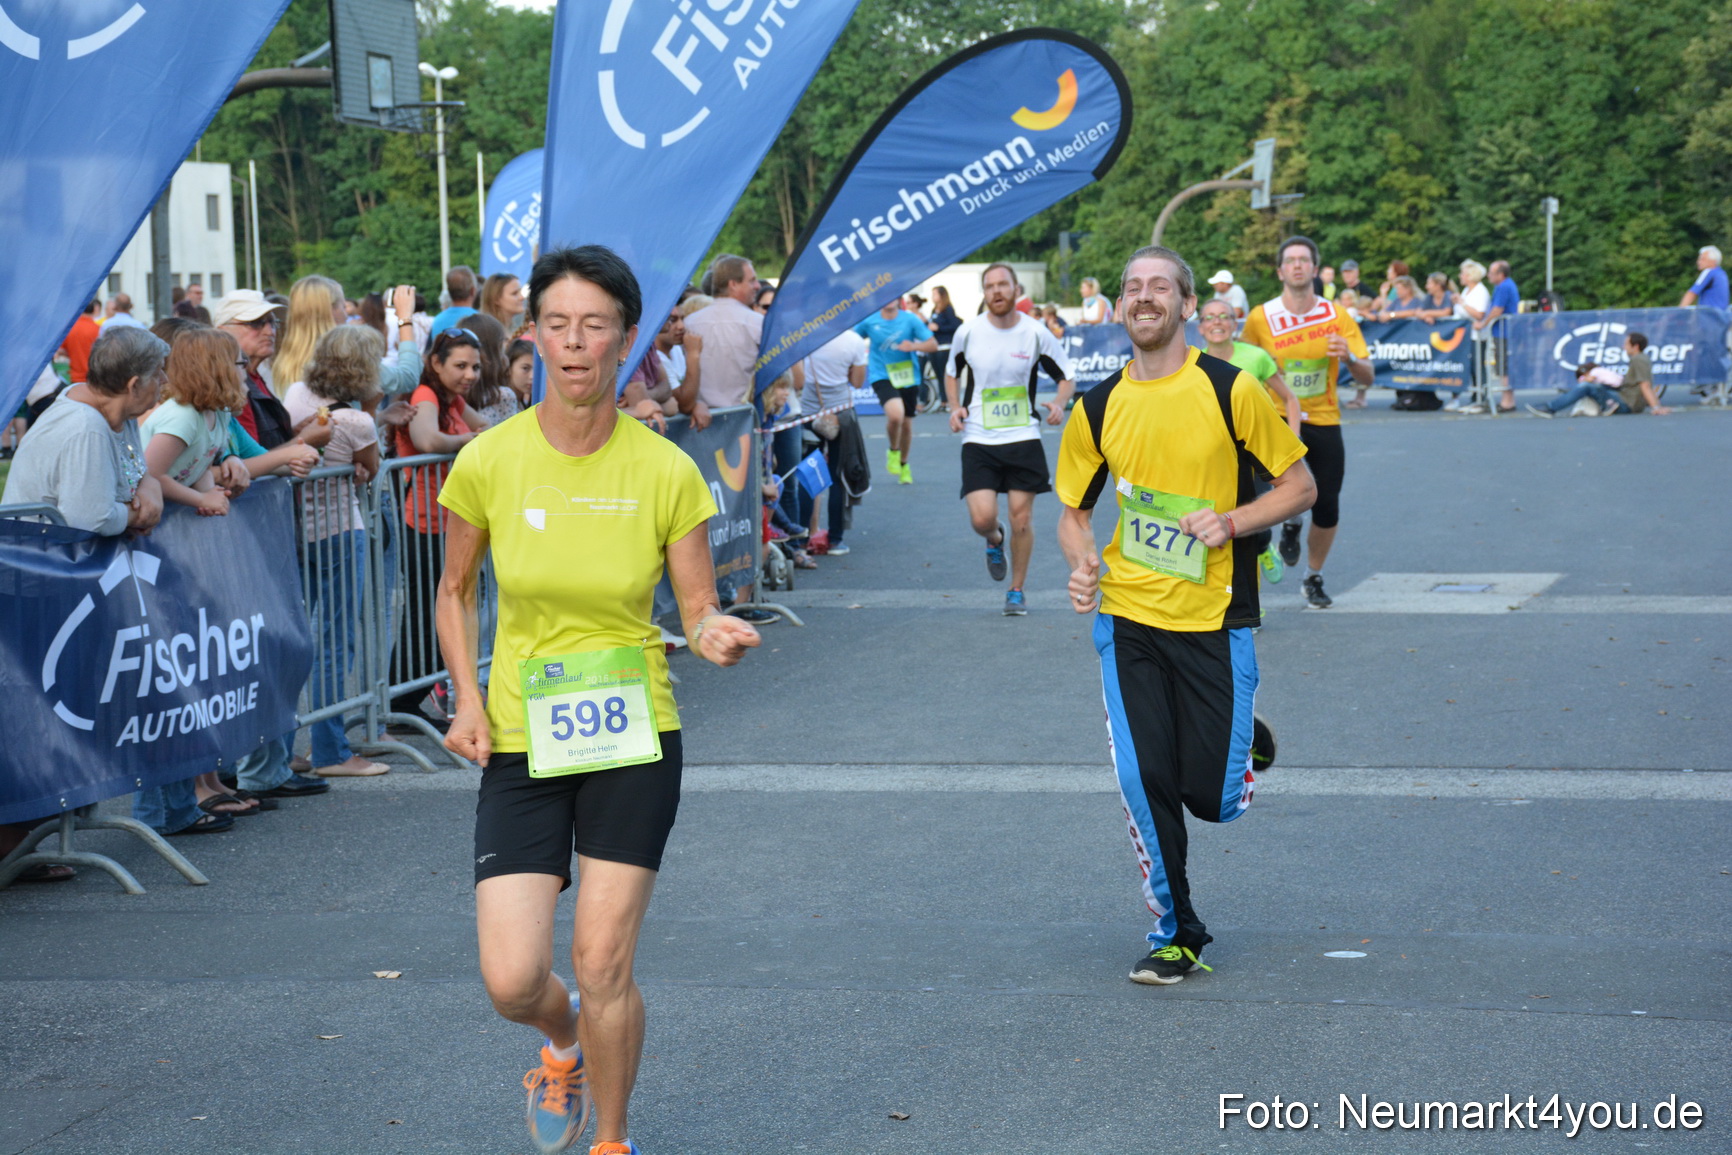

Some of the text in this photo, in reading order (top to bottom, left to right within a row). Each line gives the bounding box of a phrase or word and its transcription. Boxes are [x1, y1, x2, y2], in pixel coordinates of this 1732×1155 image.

[959, 120, 1109, 215] Druck und Medien
[818, 135, 1036, 274] Frischmann
[1274, 334, 1304, 350] MAX
[1366, 339, 1432, 360] chmann
[1293, 373, 1320, 387] 887
[992, 403, 1018, 417] 401
[1130, 518, 1198, 556] 1277
[99, 608, 265, 704] Fischer
[538, 672, 583, 687] firmenlauf
[585, 674, 609, 685] 2016
[116, 682, 259, 747] AUTOMOBILE
[551, 696, 628, 741] 598
[568, 744, 618, 757] Brigitte Helm
